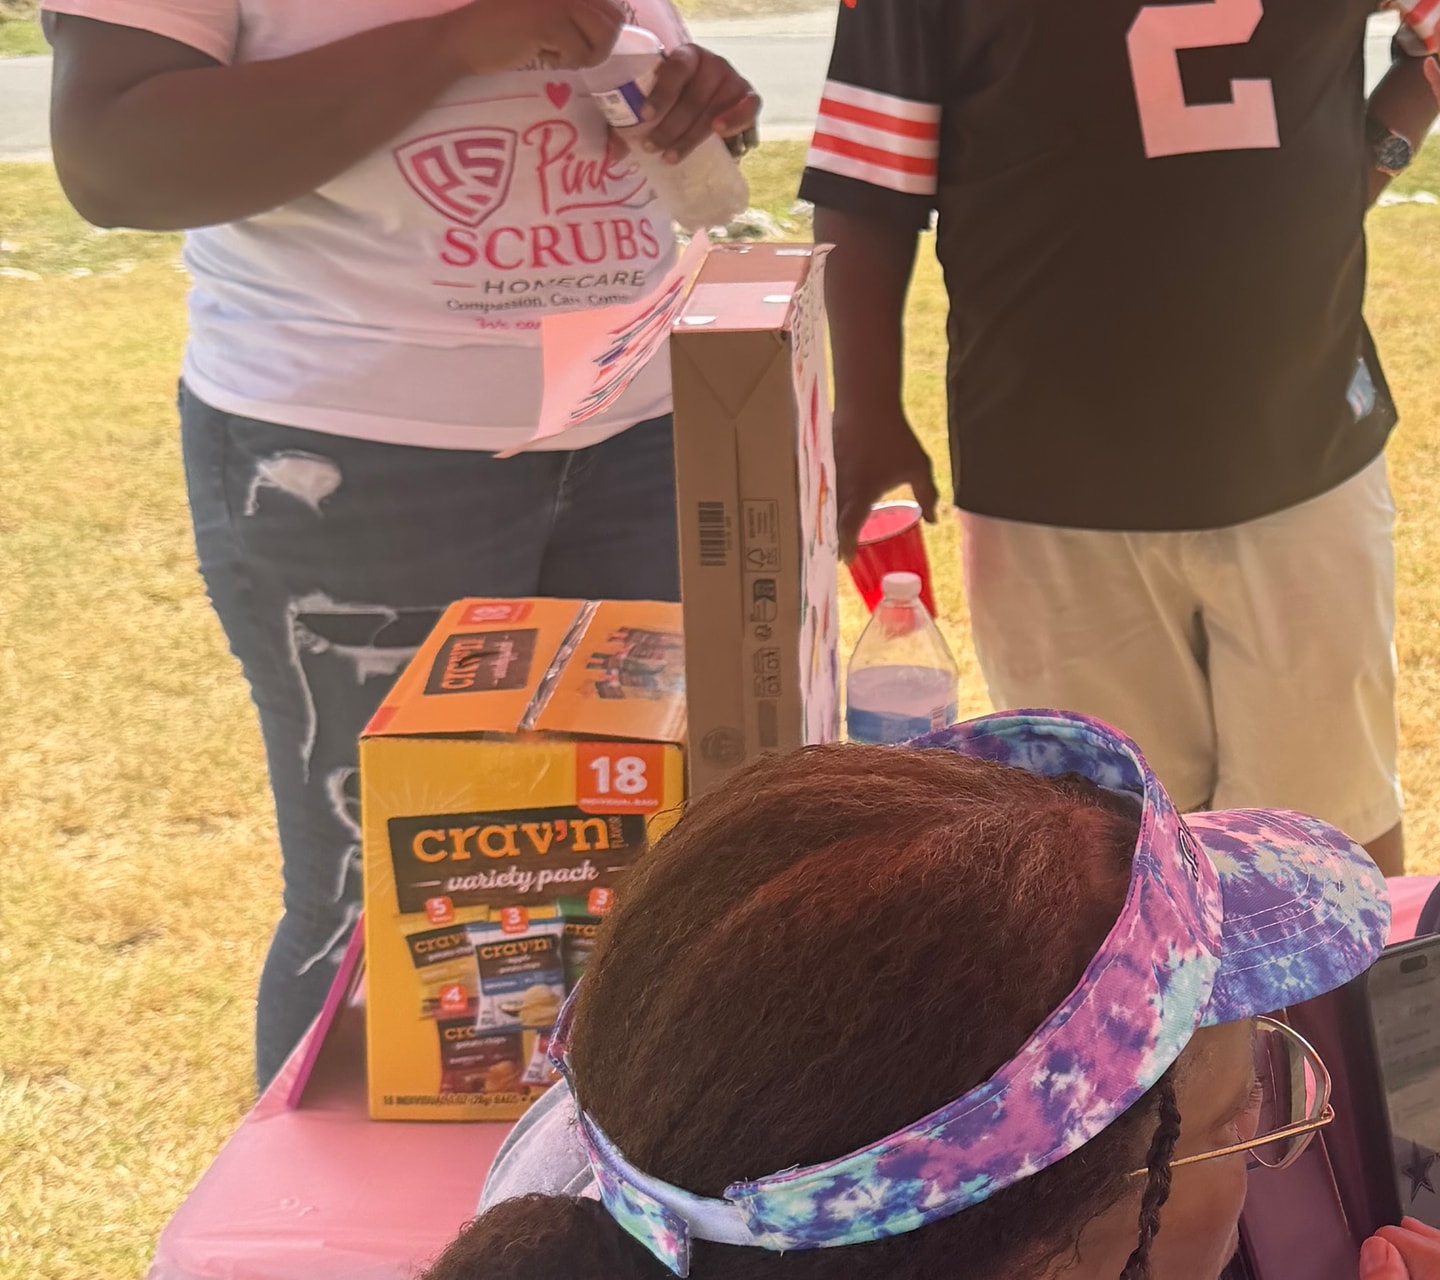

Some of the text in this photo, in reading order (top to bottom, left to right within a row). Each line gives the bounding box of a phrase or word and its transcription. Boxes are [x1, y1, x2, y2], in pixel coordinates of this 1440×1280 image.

[521, 119, 638, 216] Pink
[440, 218, 661, 270] SCRUBS
[484, 270, 646, 294] HOMECARE
[590, 756, 648, 794] 18
[412, 817, 609, 863] crav'n
[447, 860, 600, 894] variety pack
[432, 898, 447, 916] 5
[508, 907, 521, 925] 3
[446, 986, 461, 1002] 4
